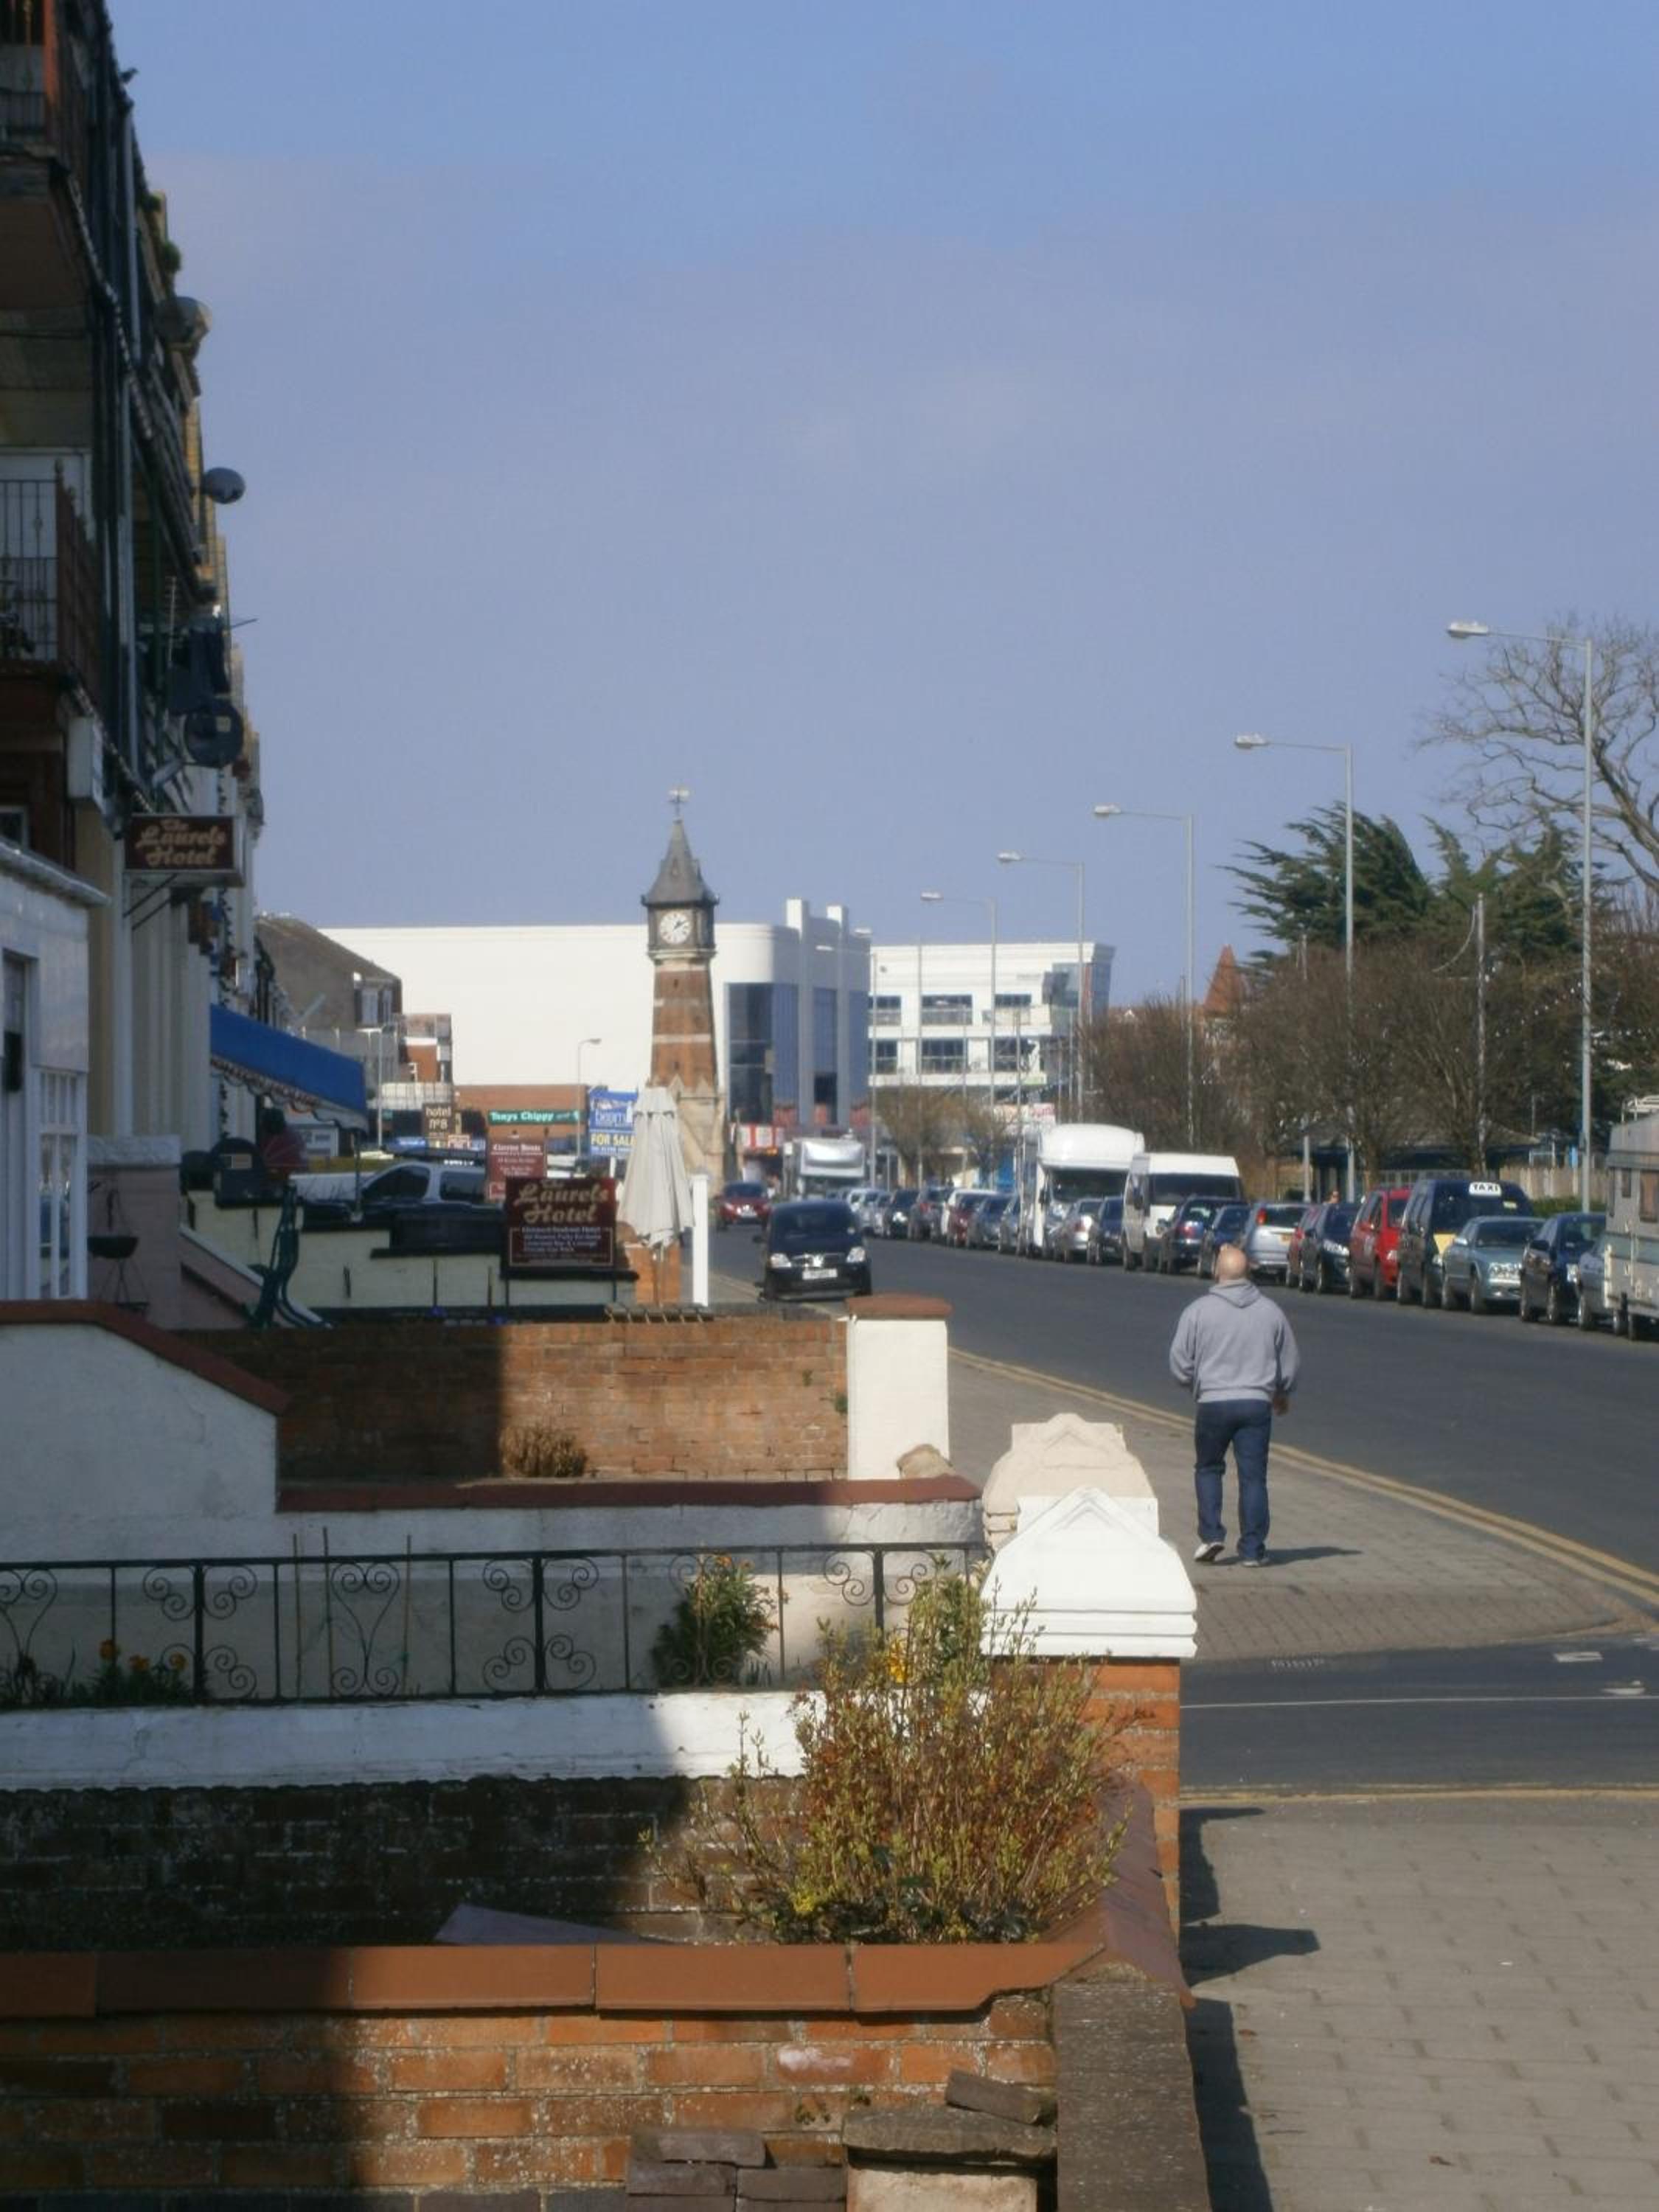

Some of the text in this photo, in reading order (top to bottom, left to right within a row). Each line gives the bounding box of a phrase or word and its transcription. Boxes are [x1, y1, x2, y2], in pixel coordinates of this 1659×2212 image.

[134, 825, 226, 849] Laurels
[145, 846, 216, 866] Hotel
[425, 1106, 451, 1118] hotel
[521, 1110, 554, 1122] Chippy
[591, 1133, 611, 1145] FOR
[513, 1183, 609, 1206] Laurels
[1473, 1183, 1499, 1192] TAXI
[523, 1203, 598, 1225] Hotel
